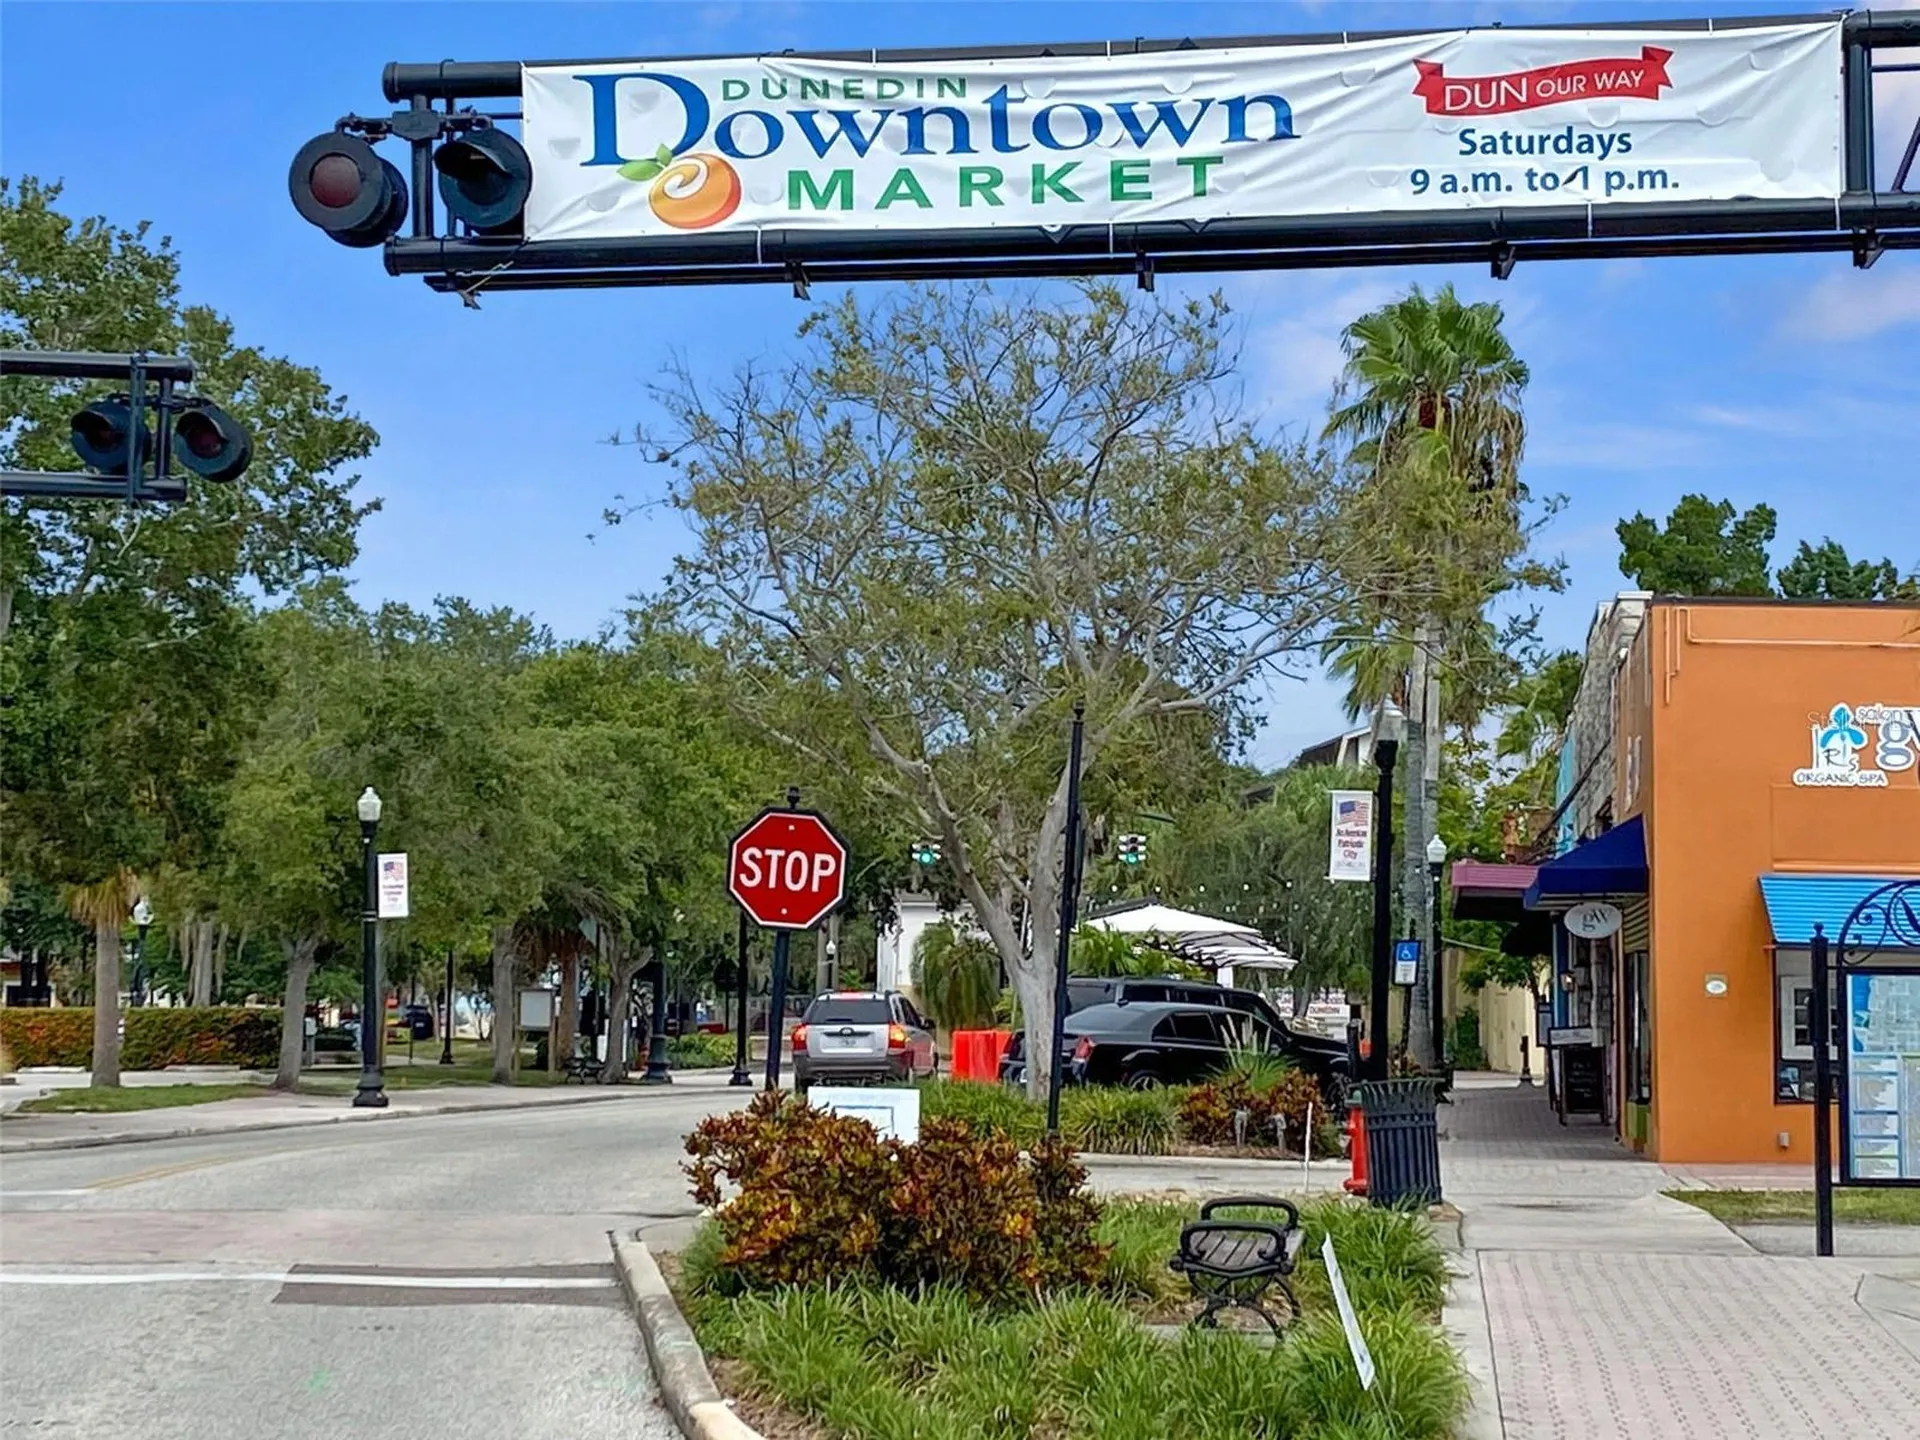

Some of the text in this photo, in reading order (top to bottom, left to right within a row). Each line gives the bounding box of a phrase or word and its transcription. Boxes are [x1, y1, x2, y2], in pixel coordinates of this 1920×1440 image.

[722, 76, 968, 101] DUNEDIN
[1445, 70, 1645, 111] DUN OUR WAY
[572, 72, 1302, 167] Downtown
[1458, 125, 1633, 161] Saturdays
[787, 155, 1224, 211] MARKET
[1410, 168, 1430, 195] 9
[1440, 167, 1512, 194] a.m.
[1525, 167, 1560, 192] to
[1605, 167, 1680, 197] p.m.
[1796, 772, 1884, 784] ORGANIC SPA
[739, 846, 836, 893] STOP
